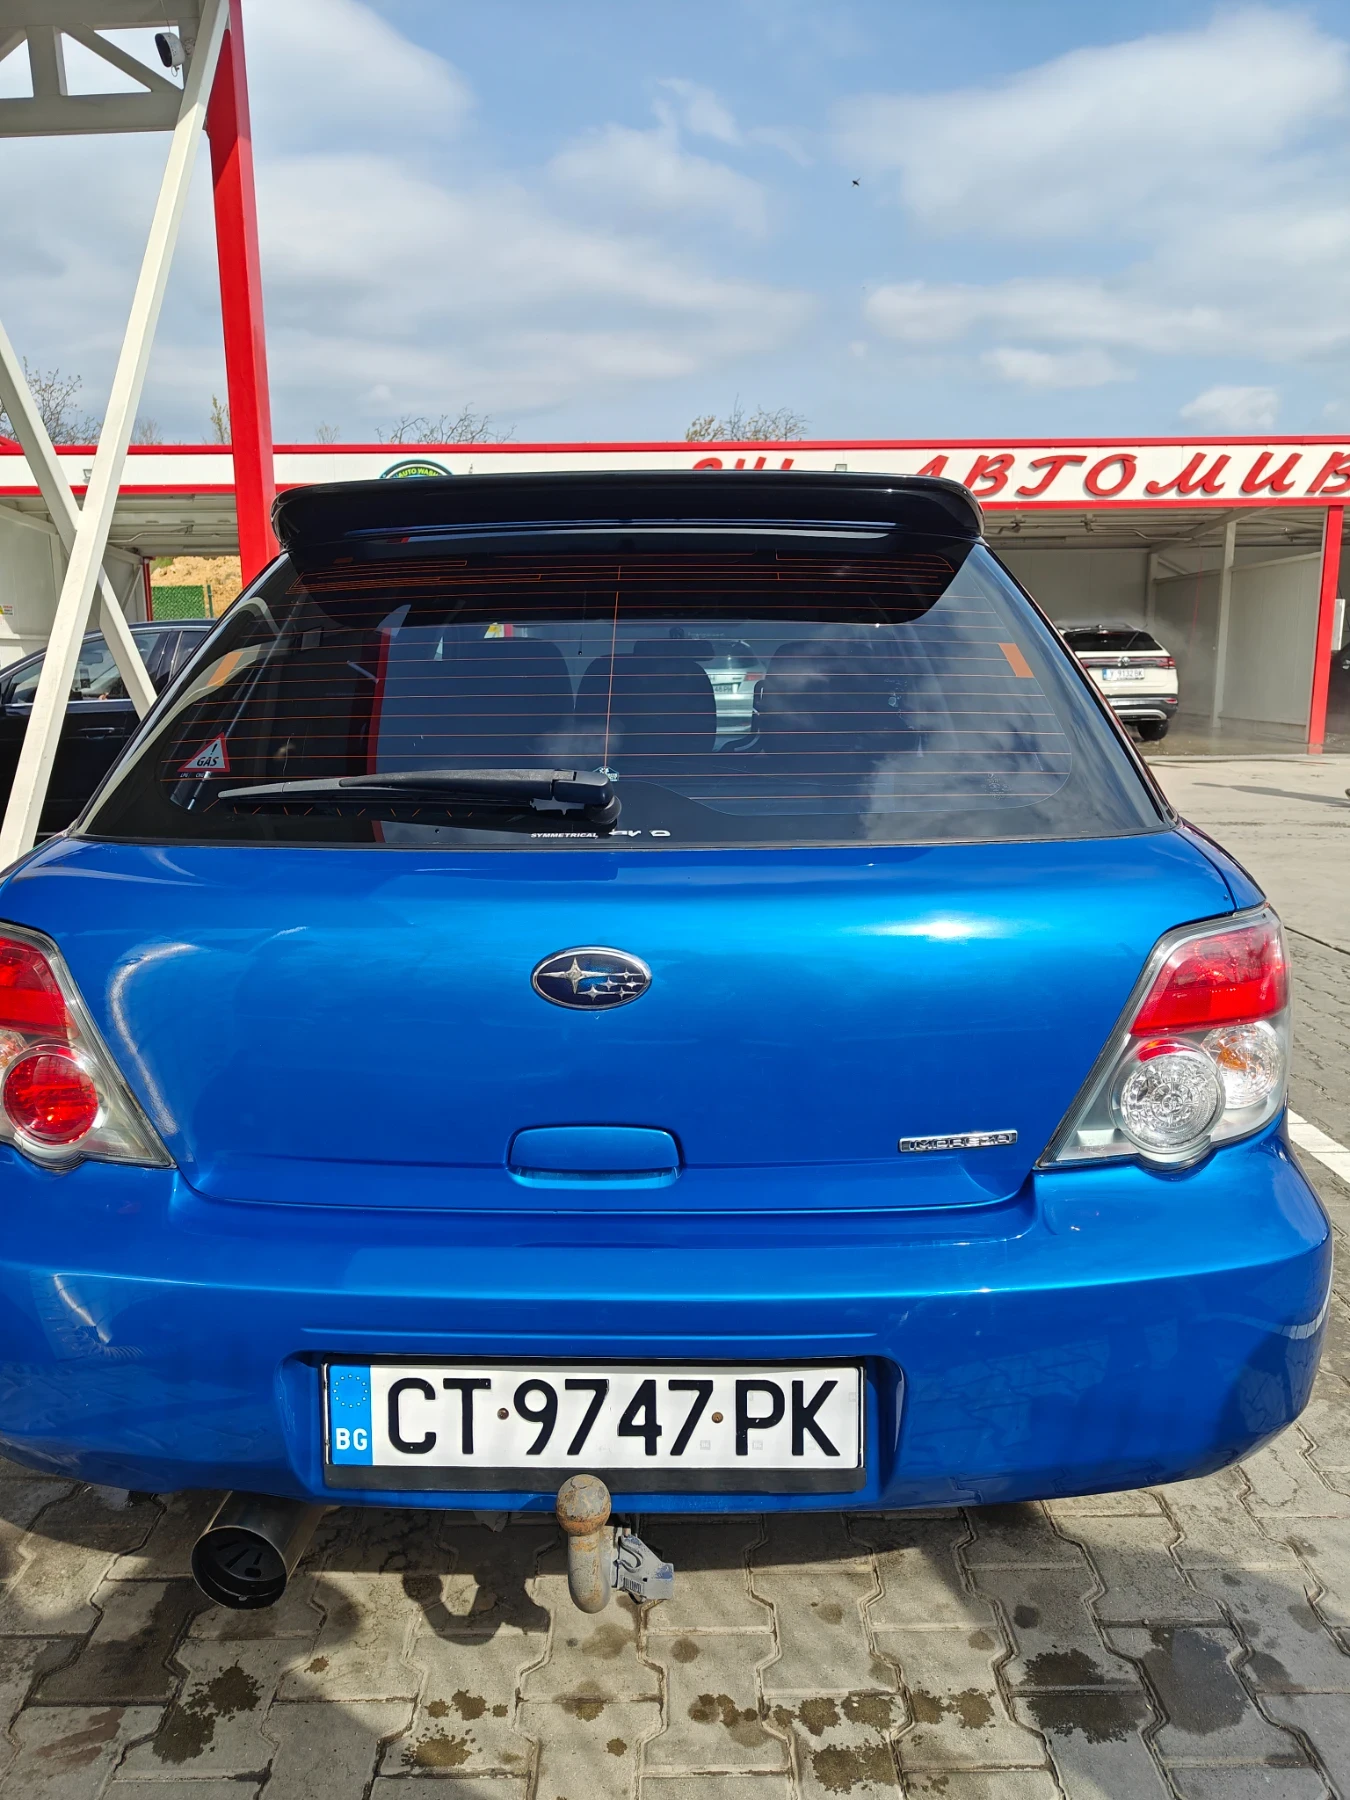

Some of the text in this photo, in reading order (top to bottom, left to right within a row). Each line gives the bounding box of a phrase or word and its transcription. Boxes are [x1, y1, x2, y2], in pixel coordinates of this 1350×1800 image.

[398, 468, 417, 478] AUTO
[196, 756, 219, 767] GAS
[387, 1377, 841, 1456] CT 9747 PK
[335, 1427, 369, 1452] BG
